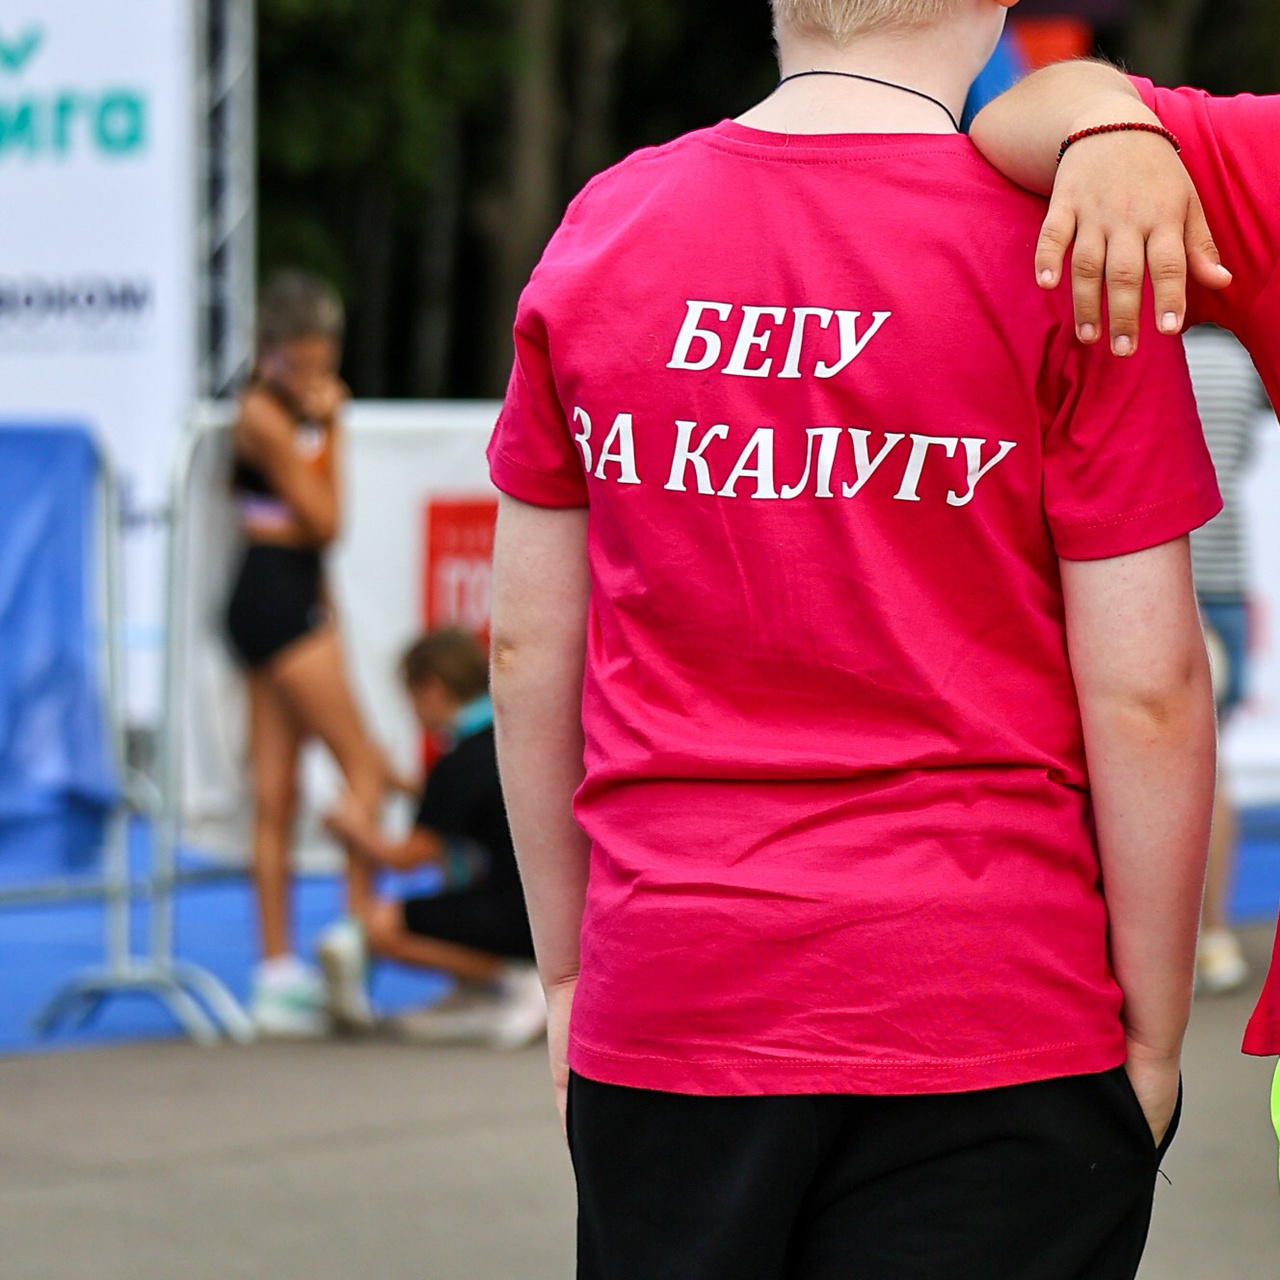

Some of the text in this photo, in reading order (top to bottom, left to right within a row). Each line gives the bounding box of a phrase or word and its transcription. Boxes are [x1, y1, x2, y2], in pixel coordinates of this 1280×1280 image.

[0, 19, 149, 158] йга
[666, 300, 891, 379] БЕГУ
[573, 405, 1017, 506] ЗА КАЛУГУ
